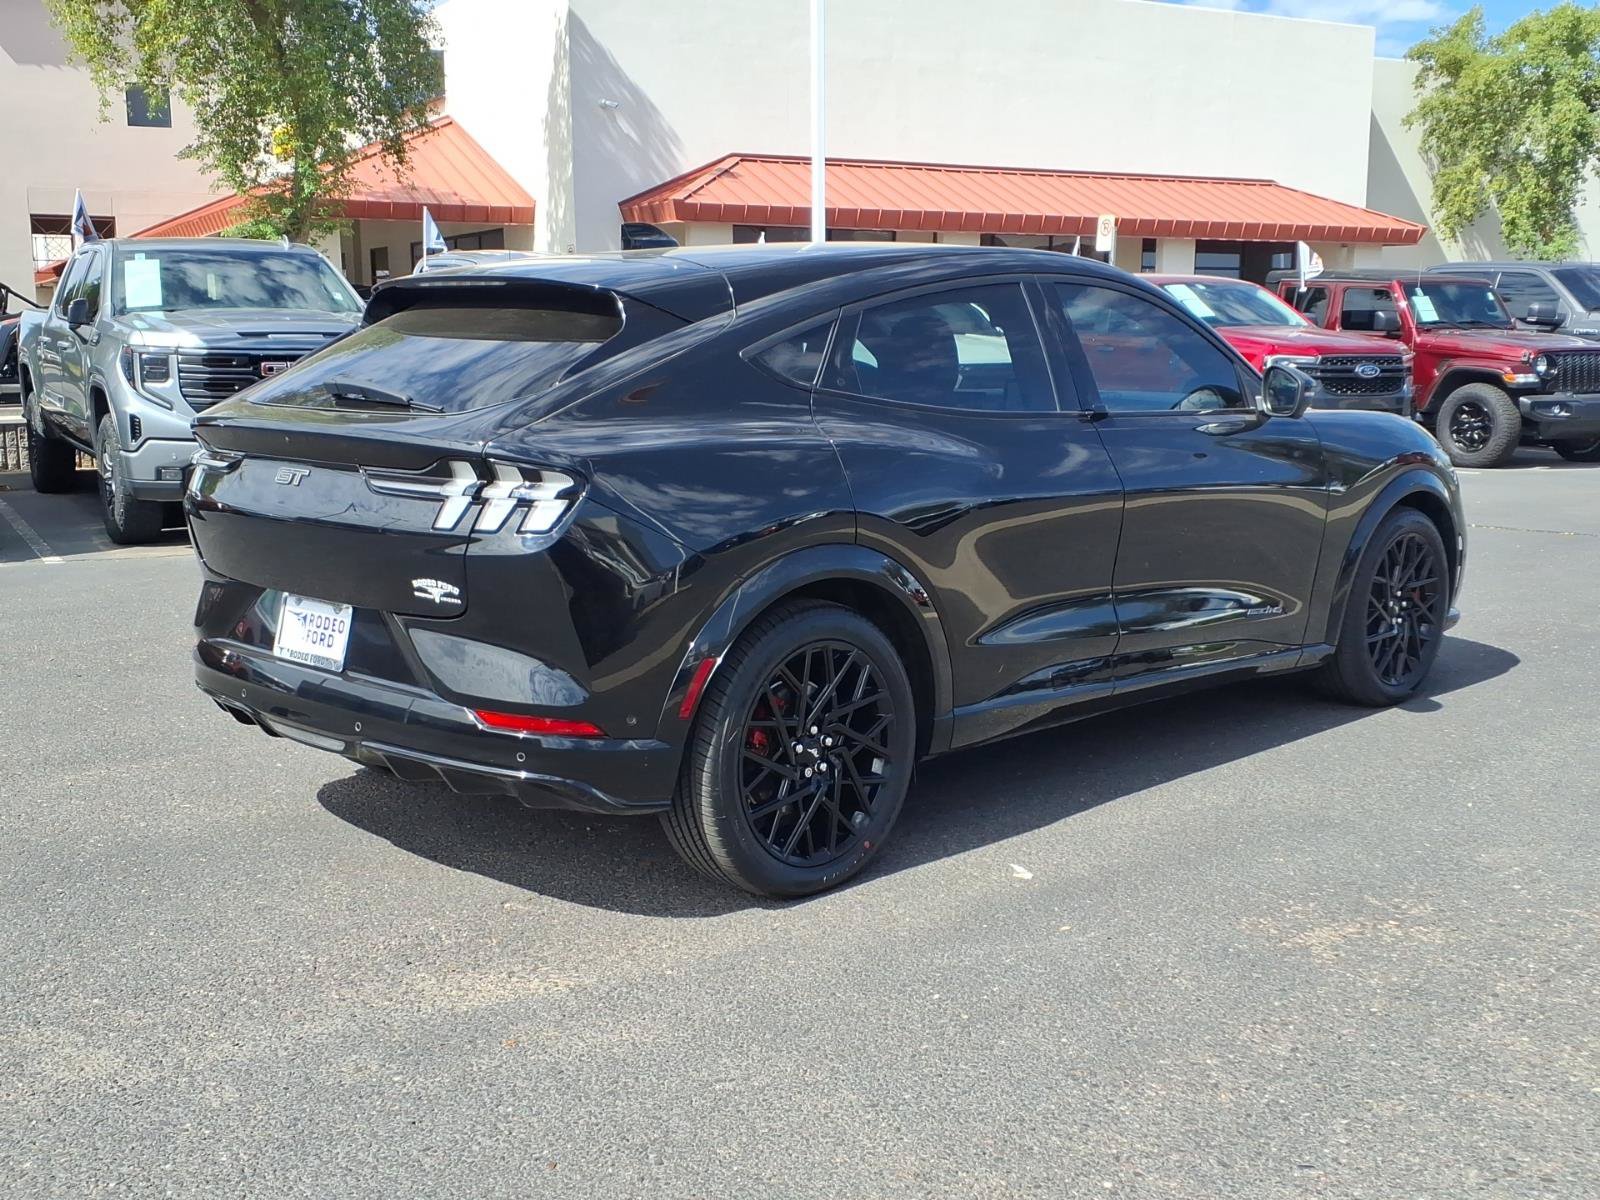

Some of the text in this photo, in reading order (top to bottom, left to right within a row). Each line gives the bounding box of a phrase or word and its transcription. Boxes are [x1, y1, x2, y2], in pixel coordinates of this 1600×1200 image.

[275, 467, 311, 486] GT
[308, 613, 346, 634] RODEO
[305, 629, 335, 648] FORD
